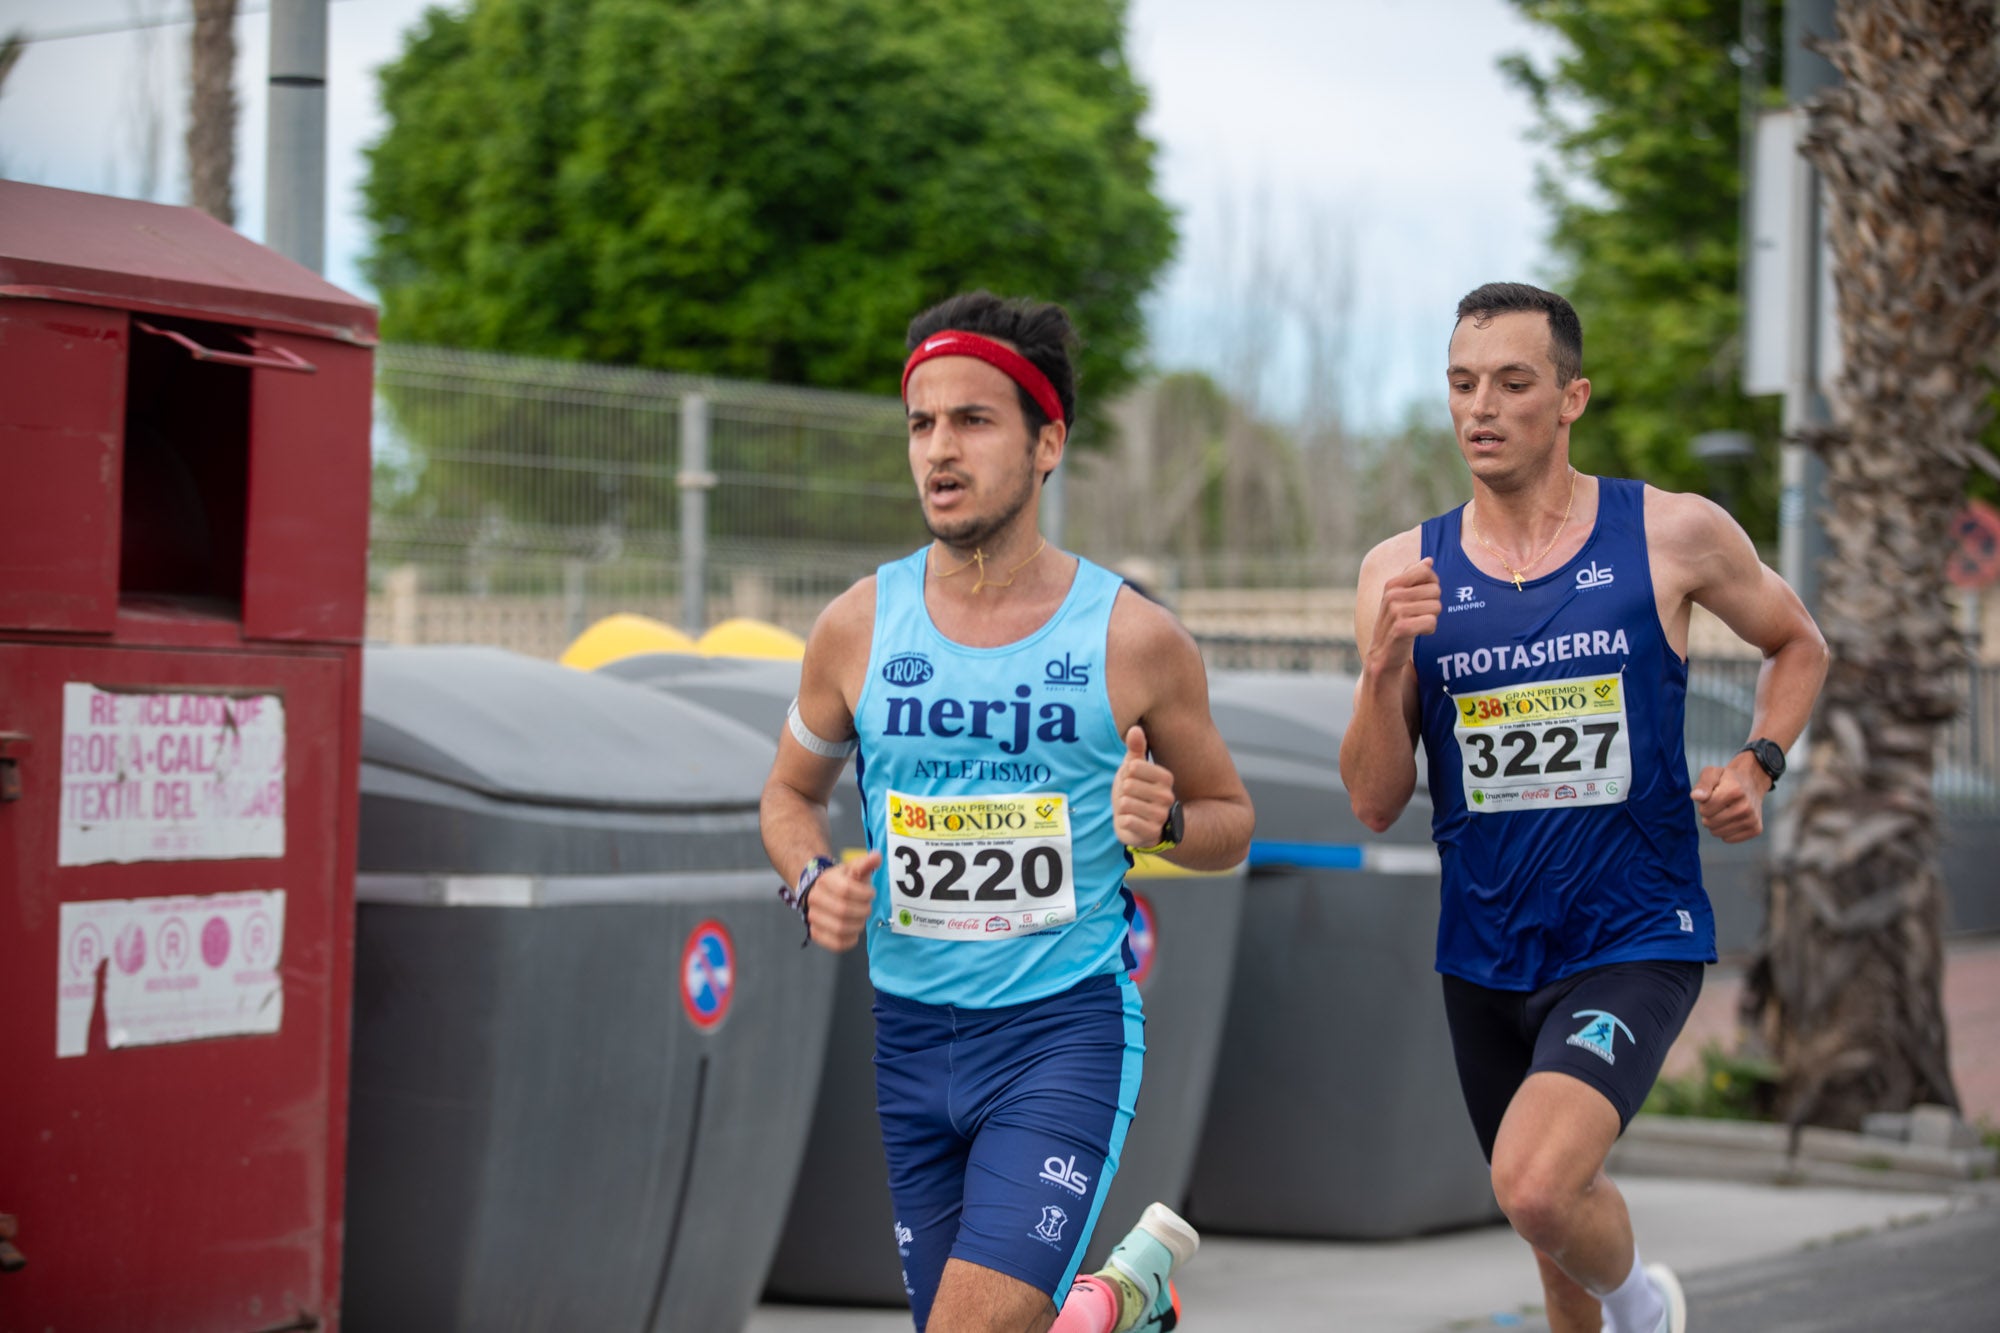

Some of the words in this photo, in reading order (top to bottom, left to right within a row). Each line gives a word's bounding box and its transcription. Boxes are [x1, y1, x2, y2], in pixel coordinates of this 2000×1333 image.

[1576, 560, 1614, 590] als
[884, 658, 932, 683] TROPS
[1043, 651, 1089, 686] als
[1437, 628, 1630, 682] TROTASIERRA
[90, 693, 227, 727] REICLADO
[882, 684, 1080, 755] nerja
[1477, 698, 1504, 720] 38
[1505, 690, 1535, 701] GRAN
[1537, 685, 1578, 697] PREMIO
[1502, 693, 1587, 718] FONDO
[1465, 721, 1620, 779] 3227
[913, 759, 1052, 784] ATLETISMO
[154, 780, 198, 820] DEL
[903, 804, 928, 830] 38
[932, 804, 966, 814] GRAN
[970, 803, 1016, 813] PREMIO
[928, 811, 1026, 832] FONDO
[894, 844, 1063, 902] 3220
[1038, 1154, 1089, 1196] als
